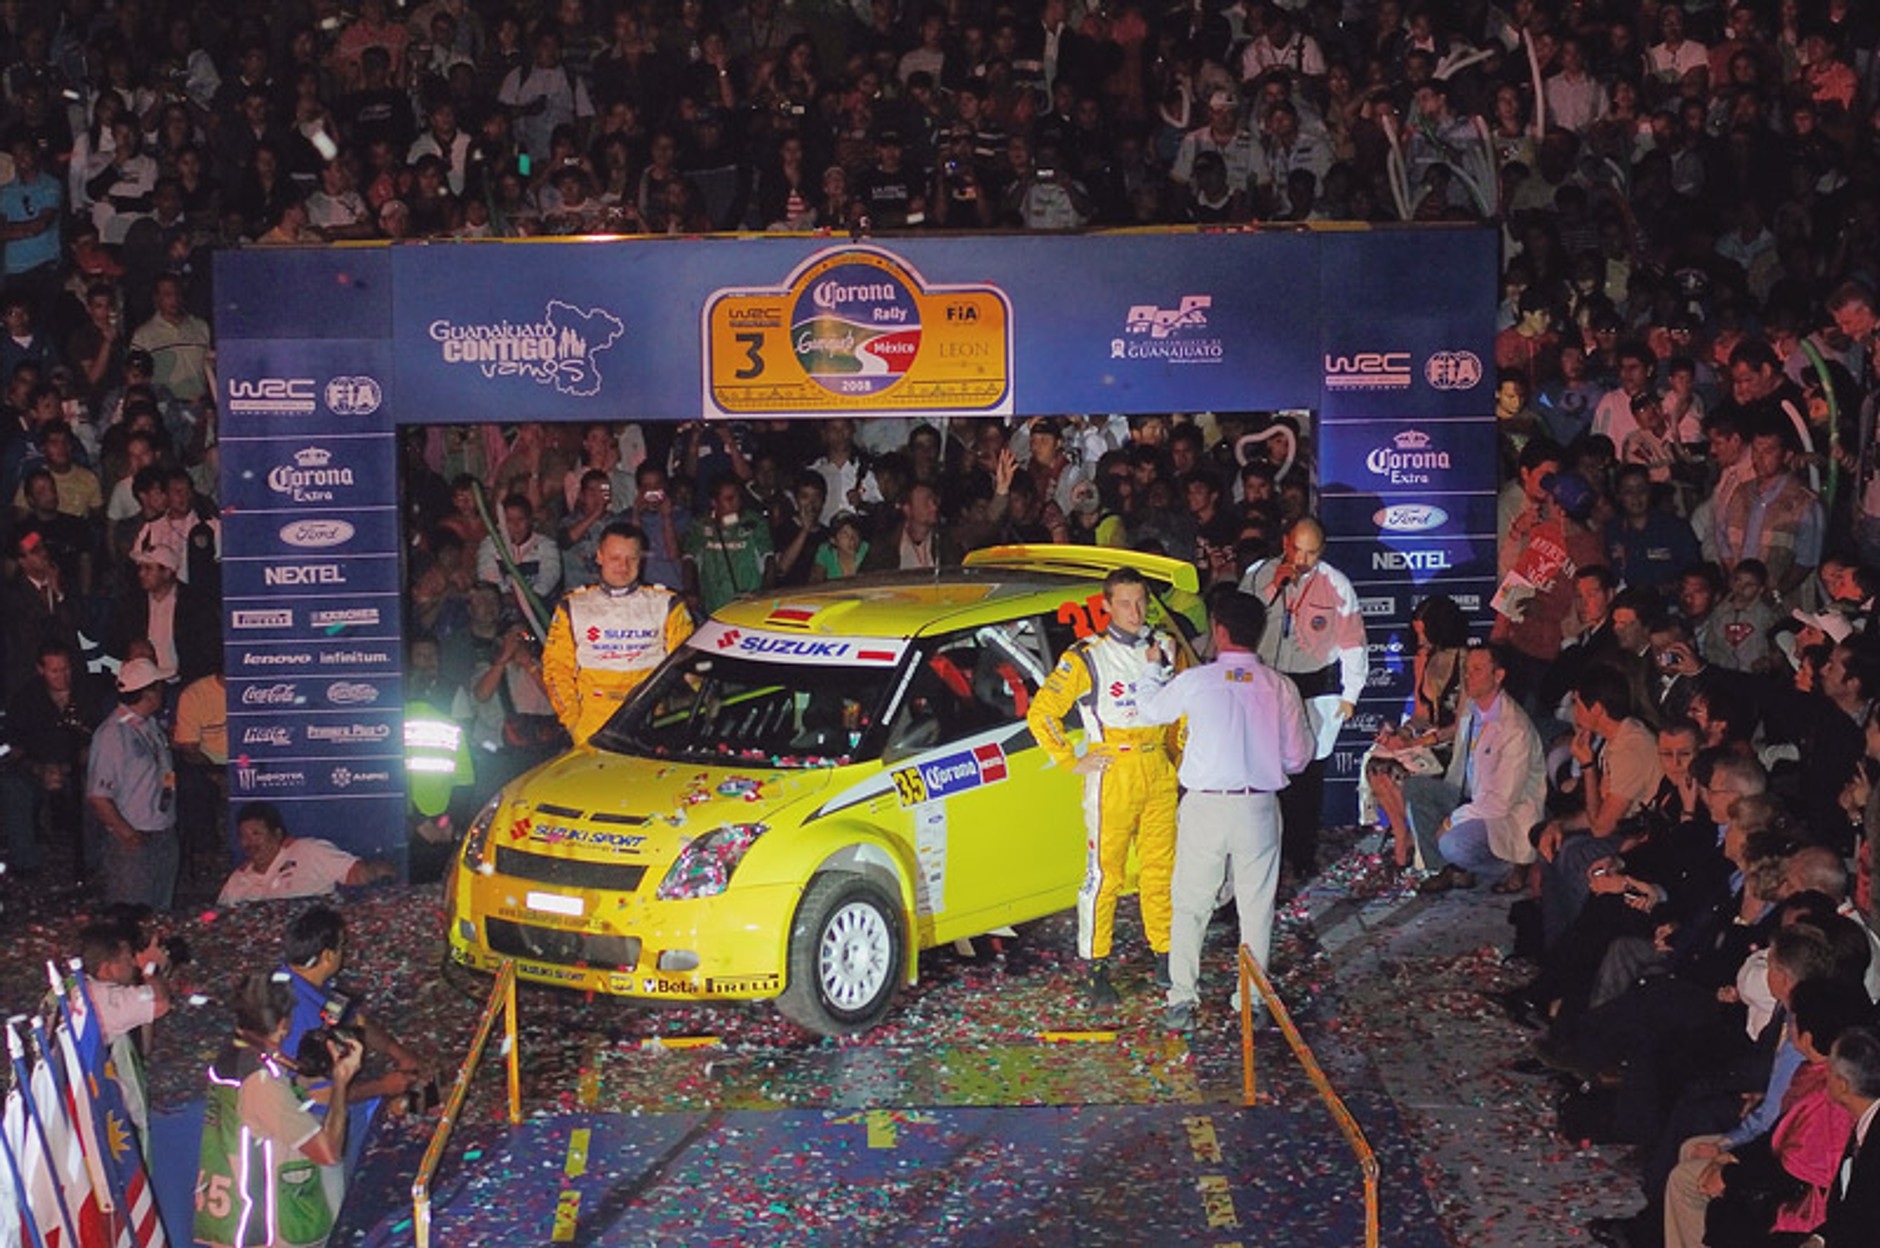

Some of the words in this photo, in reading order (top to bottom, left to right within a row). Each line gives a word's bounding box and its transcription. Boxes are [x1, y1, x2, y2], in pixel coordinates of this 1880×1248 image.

[813, 282, 896, 308] Corona
[729, 307, 782, 319] WRC
[873, 307, 908, 322] Rally
[429, 319, 557, 340] Guanajuato
[443, 338, 557, 362] CONTIGO
[735, 332, 765, 379] 3
[1128, 344, 1223, 359] GUANAJUATO
[1325, 352, 1411, 373] WRC
[230, 379, 316, 397] WRC
[841, 380, 872, 392] 2008
[1366, 447, 1451, 476] Corona
[268, 466, 354, 494] Corona
[1391, 471, 1430, 484] Extra
[293, 488, 332, 502] Extra
[1388, 508, 1432, 526] Ford
[295, 525, 339, 541] Ford
[1372, 551, 1451, 570] NEXTEL
[265, 564, 346, 585] NEXTEL
[604, 629, 659, 639] SUZUKI
[740, 636, 850, 657] SUZUKI
[243, 653, 312, 665] lenovo
[926, 761, 977, 790] Corona
[892, 767, 928, 807] 35
[534, 823, 589, 841] SUZUKI
[589, 832, 647, 847] SPORT
[519, 963, 556, 976] SUZUKI
[658, 980, 699, 993] Beta
